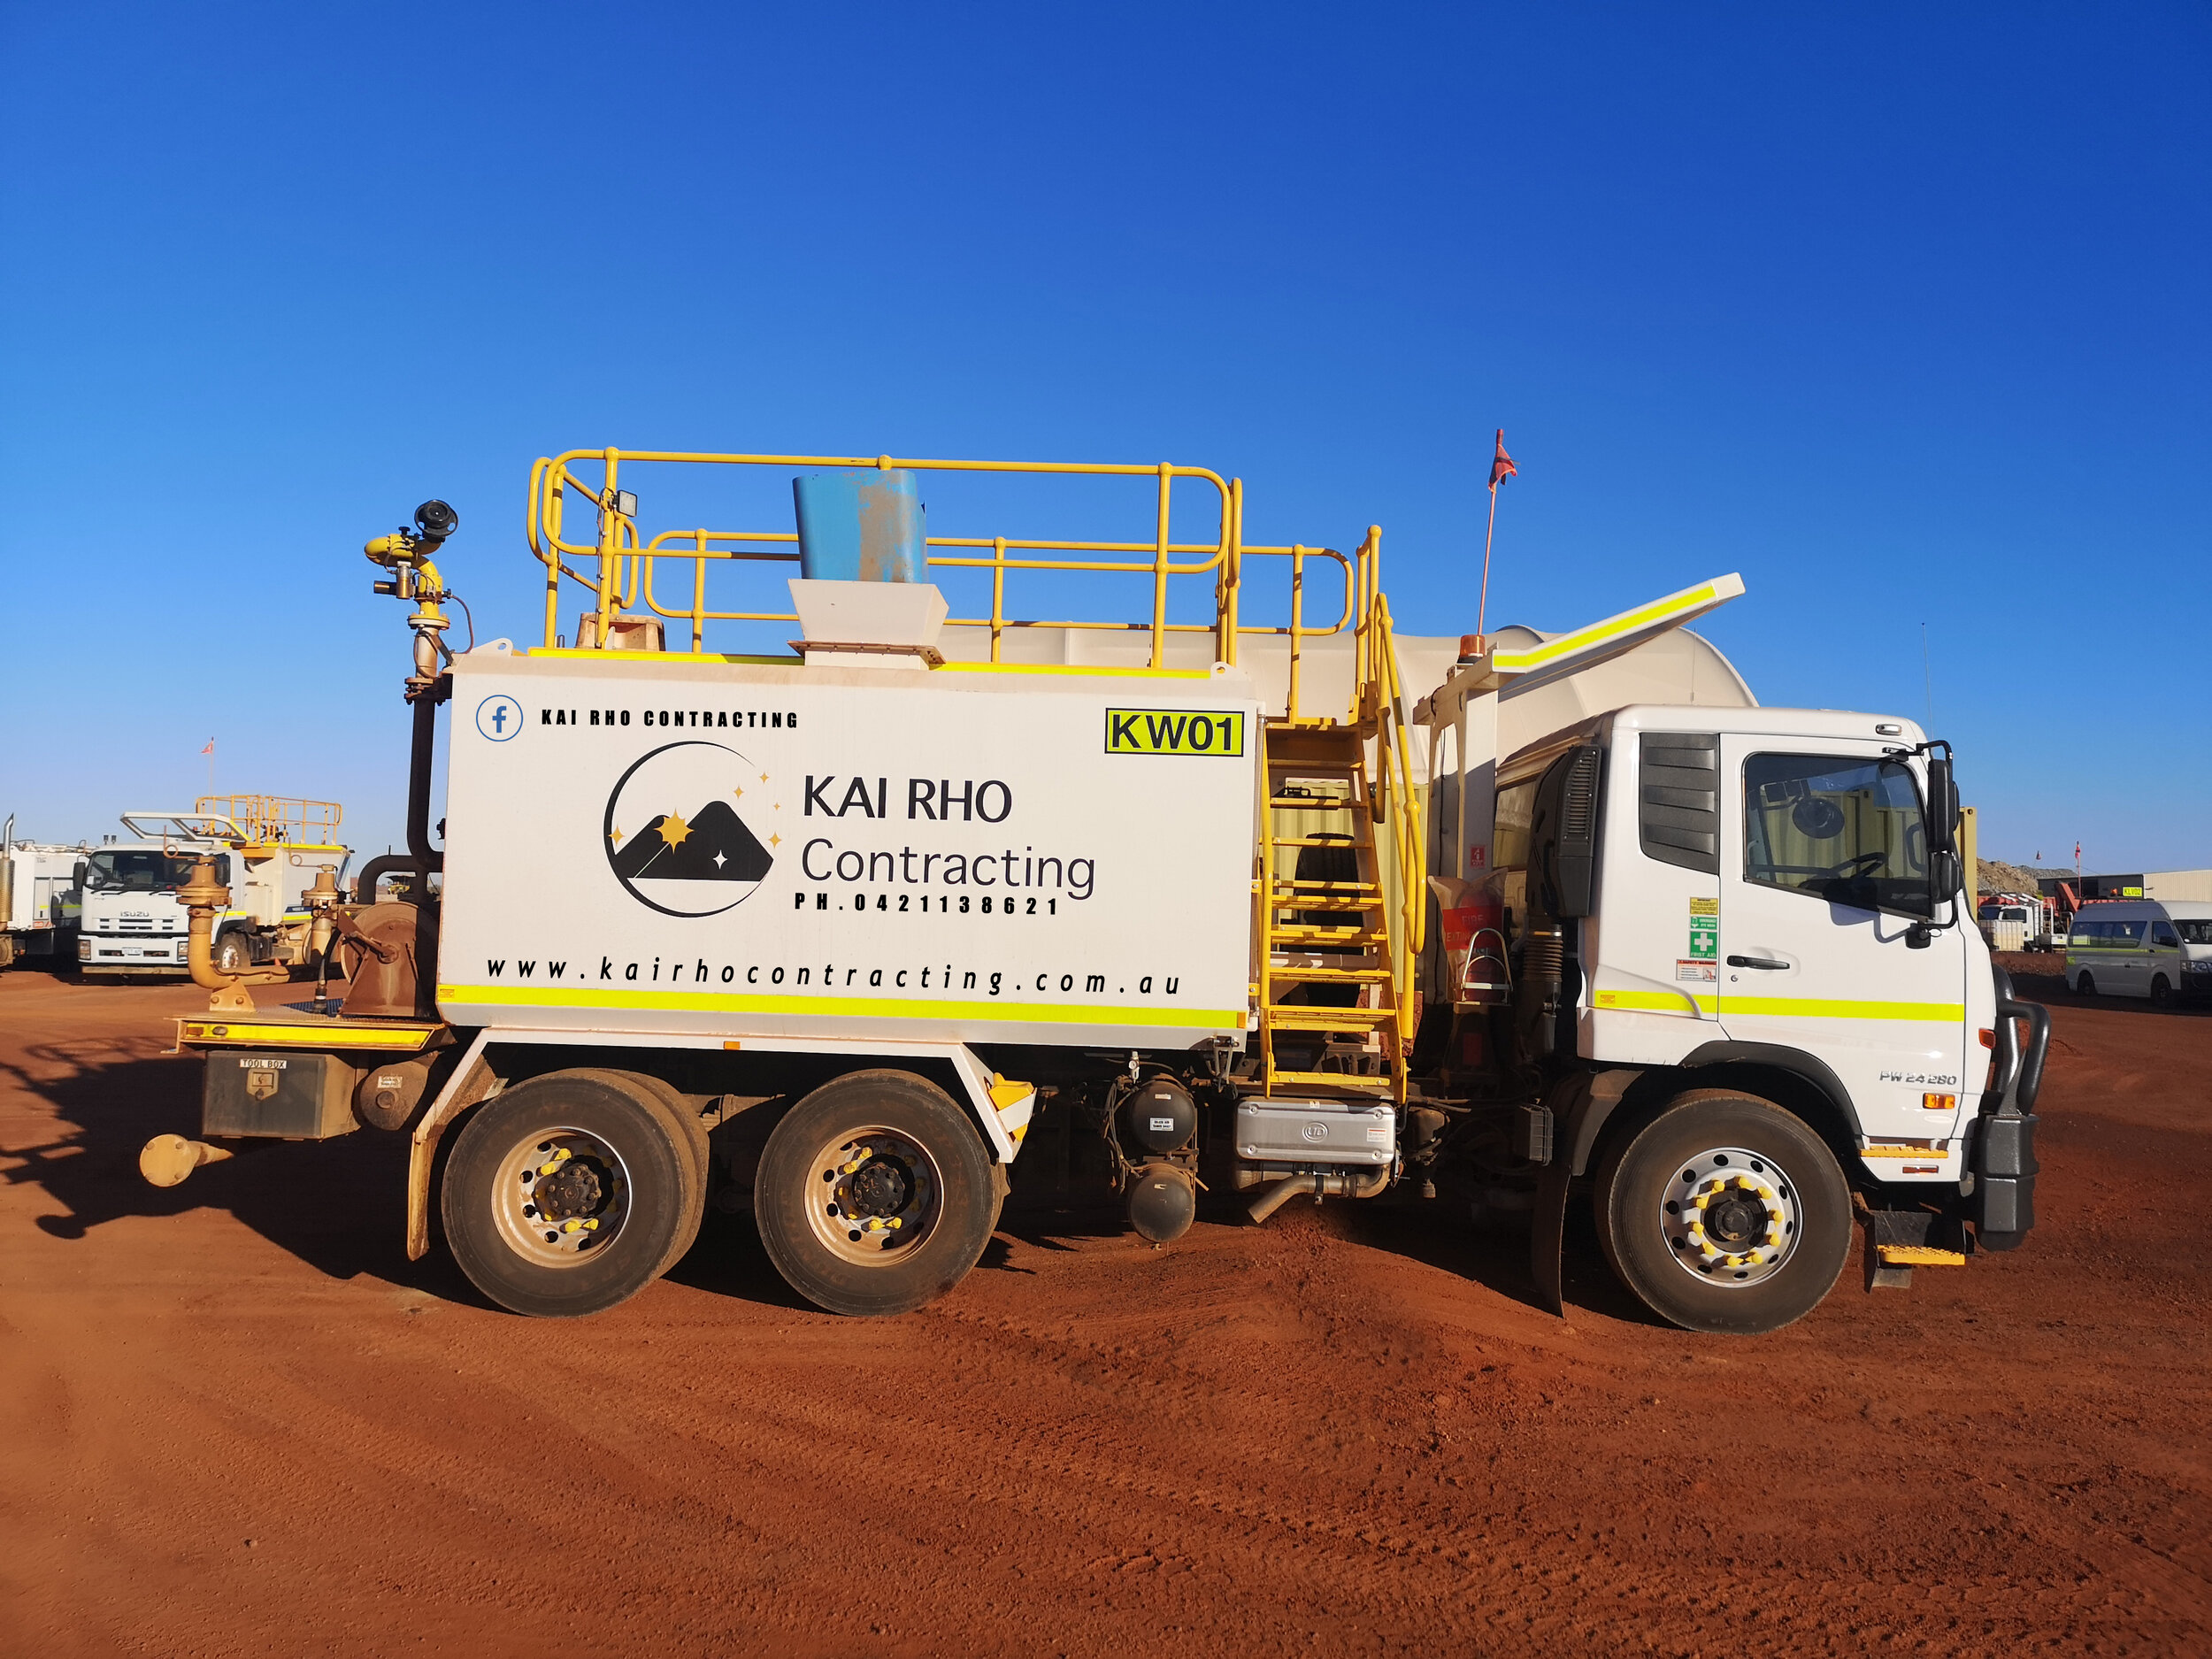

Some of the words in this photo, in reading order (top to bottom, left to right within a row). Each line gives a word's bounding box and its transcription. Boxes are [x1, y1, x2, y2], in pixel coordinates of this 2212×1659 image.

[541, 709, 577, 726] KAI
[589, 710, 631, 726] RHO
[643, 710, 797, 728] CONTRACTING
[1112, 714, 1233, 750] KW01
[803, 775, 887, 818] KAI
[908, 779, 1012, 823] RHO
[802, 838, 1095, 901] Contracting
[795, 893, 1057, 916] PH.0421138621
[488, 956, 1179, 995] www.kairhocontracting.com.au
[267, 1060, 285, 1069] BOX
[1905, 1071, 1925, 1084] 24
